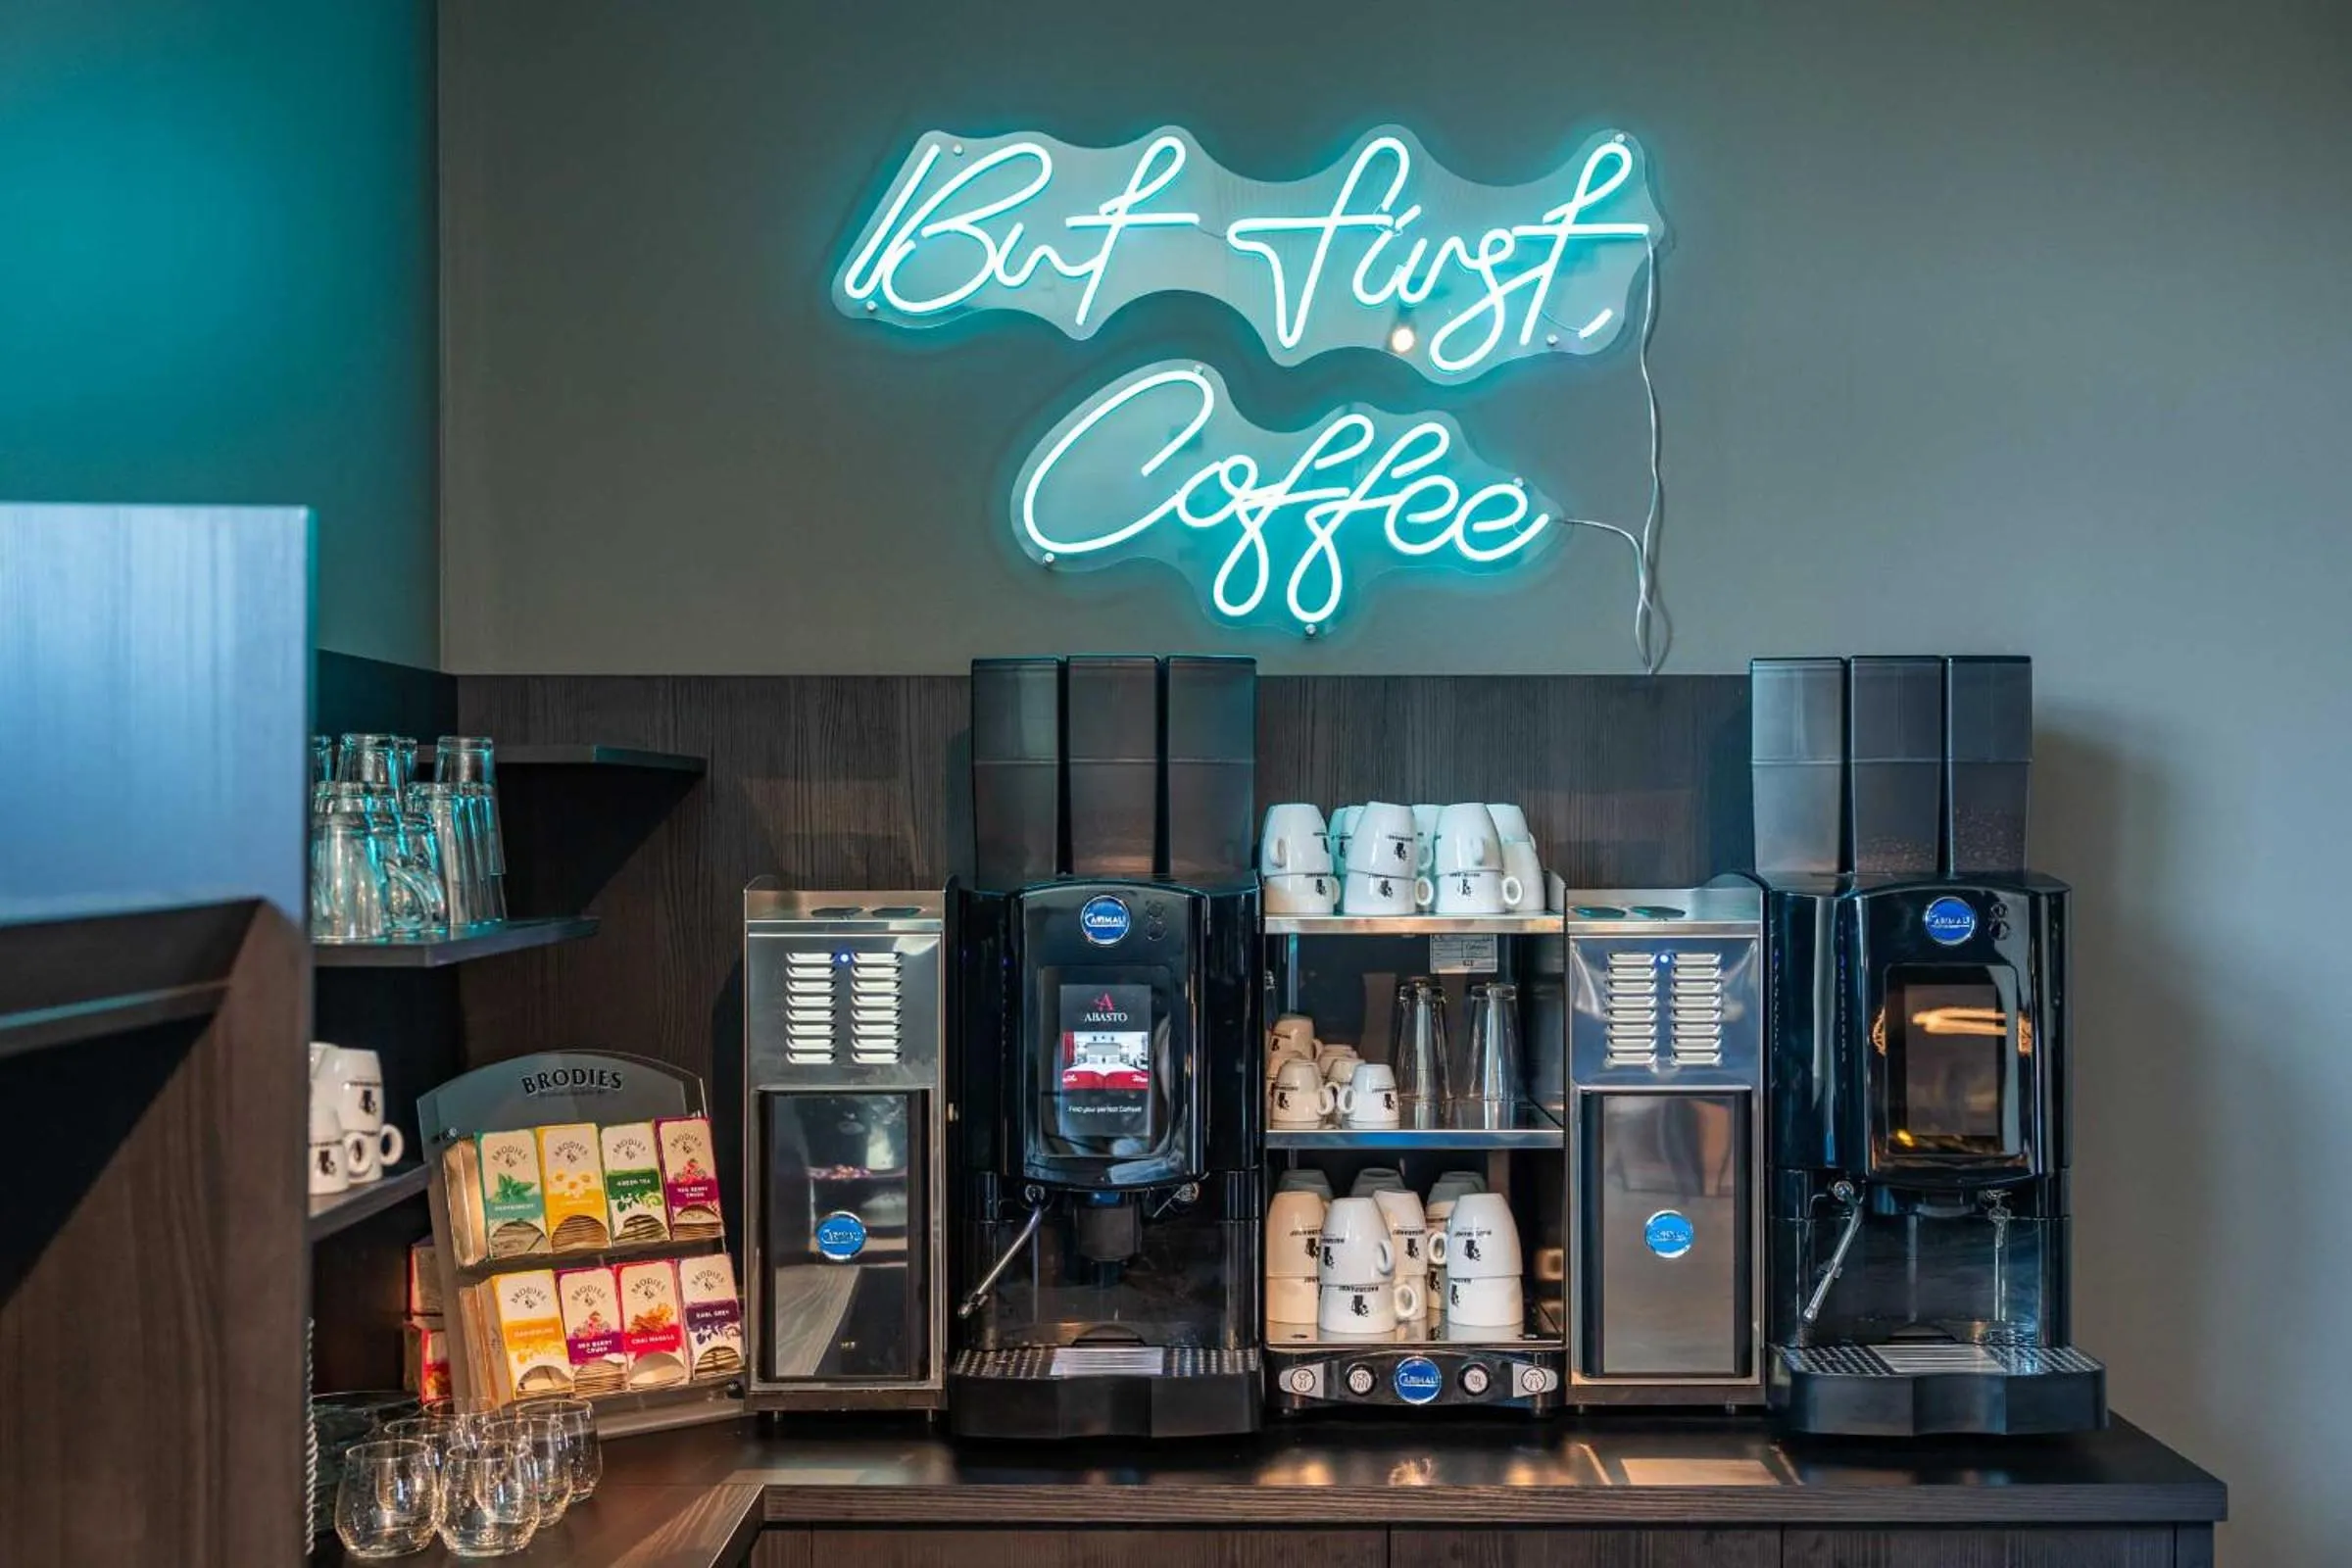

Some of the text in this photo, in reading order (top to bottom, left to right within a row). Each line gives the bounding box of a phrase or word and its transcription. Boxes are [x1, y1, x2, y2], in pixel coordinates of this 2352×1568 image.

[844, 136, 1649, 372] But first,
[1023, 369, 1550, 624] Coffee
[1083, 1012, 1128, 1023] ABASTO
[521, 1068, 622, 1095] BRODIES
[612, 1137, 647, 1154] BRODIES
[630, 1277, 666, 1296] BRODIES
[690, 1269, 725, 1286] BRODIES
[511, 1285, 548, 1304] BRODIES
[570, 1284, 607, 1301] BRODIES
